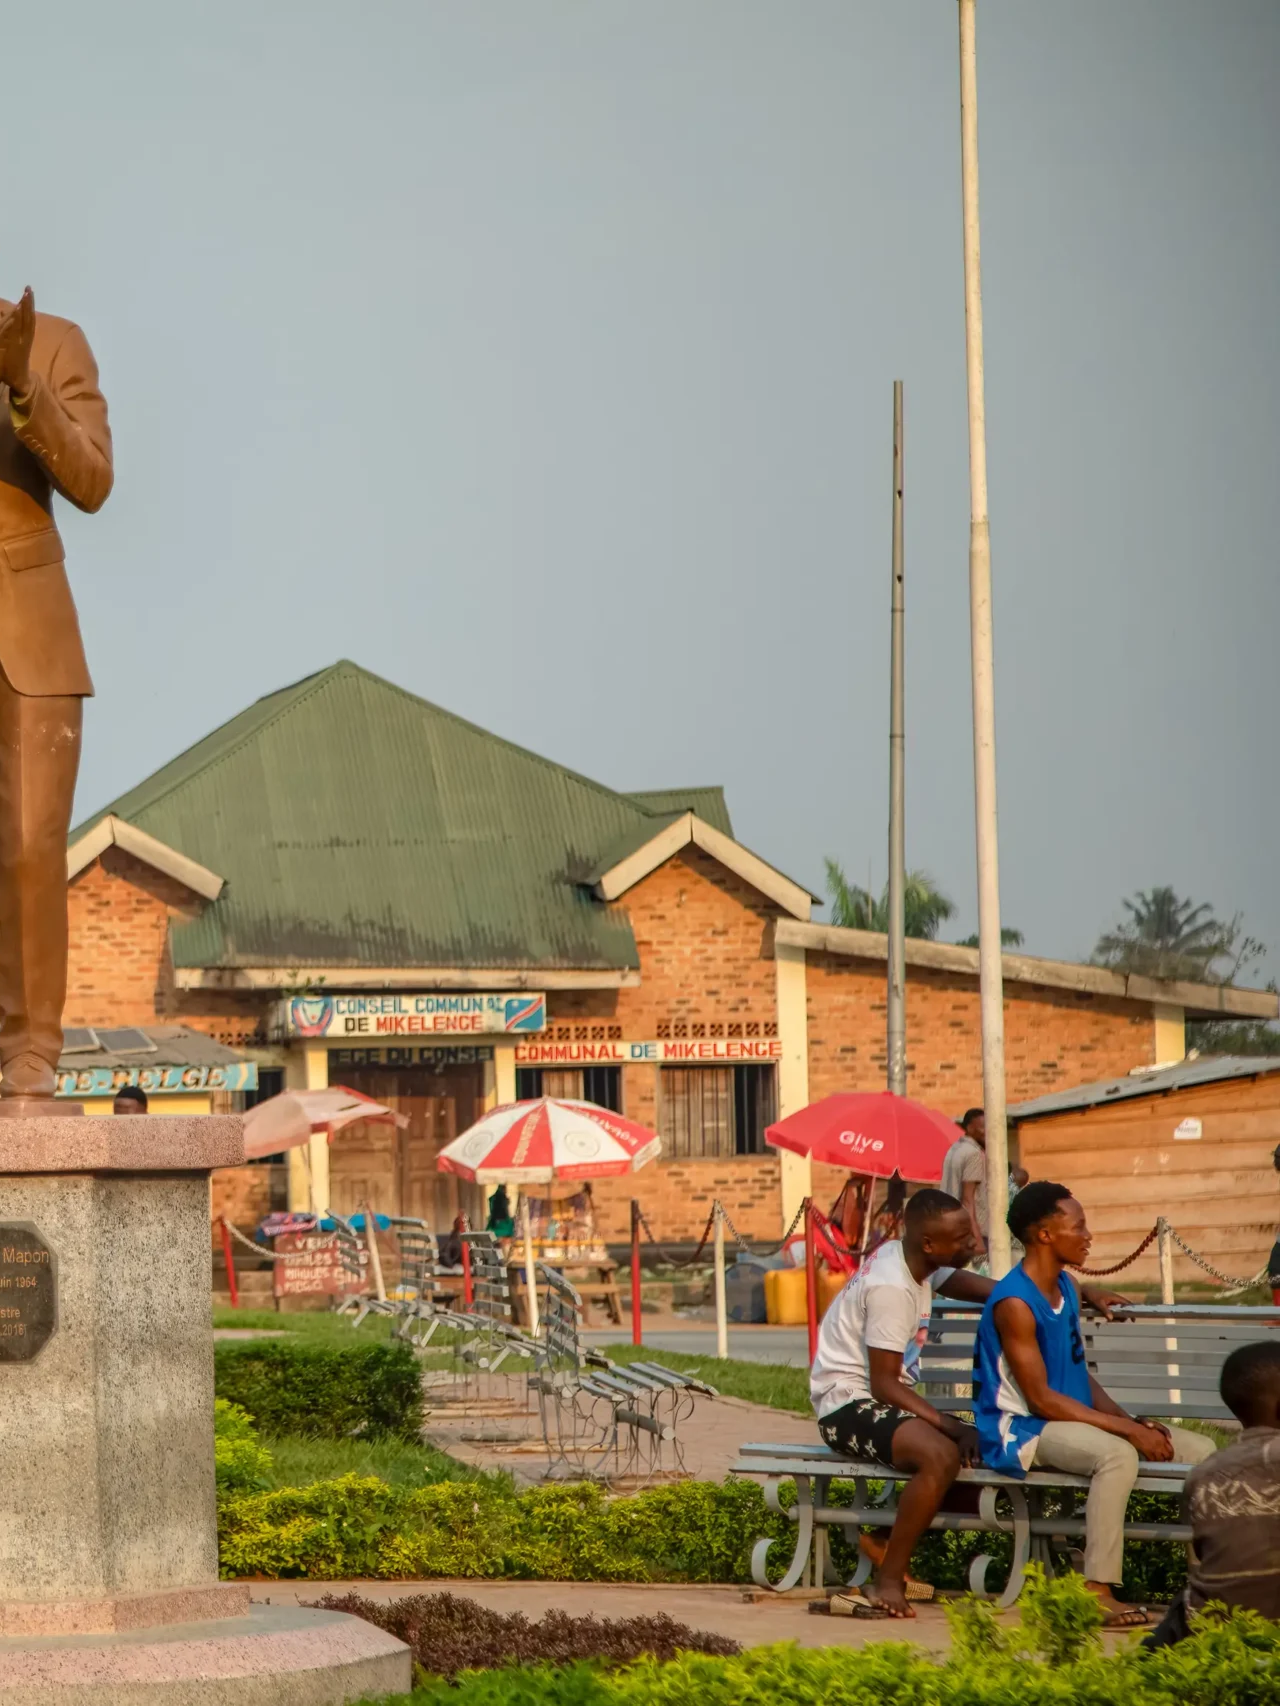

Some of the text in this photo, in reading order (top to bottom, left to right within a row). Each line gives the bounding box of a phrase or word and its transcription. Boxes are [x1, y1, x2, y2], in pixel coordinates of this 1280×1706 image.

[335, 996, 506, 1015] CONSEIL COMMUNAL
[344, 1017, 370, 1033] DE
[514, 1043, 624, 1061] COMMUNAL
[630, 1043, 657, 1059] DE
[839, 1130, 885, 1152] Give
[3, 1246, 50, 1267] Mapon
[15, 1275, 37, 1289] 1964
